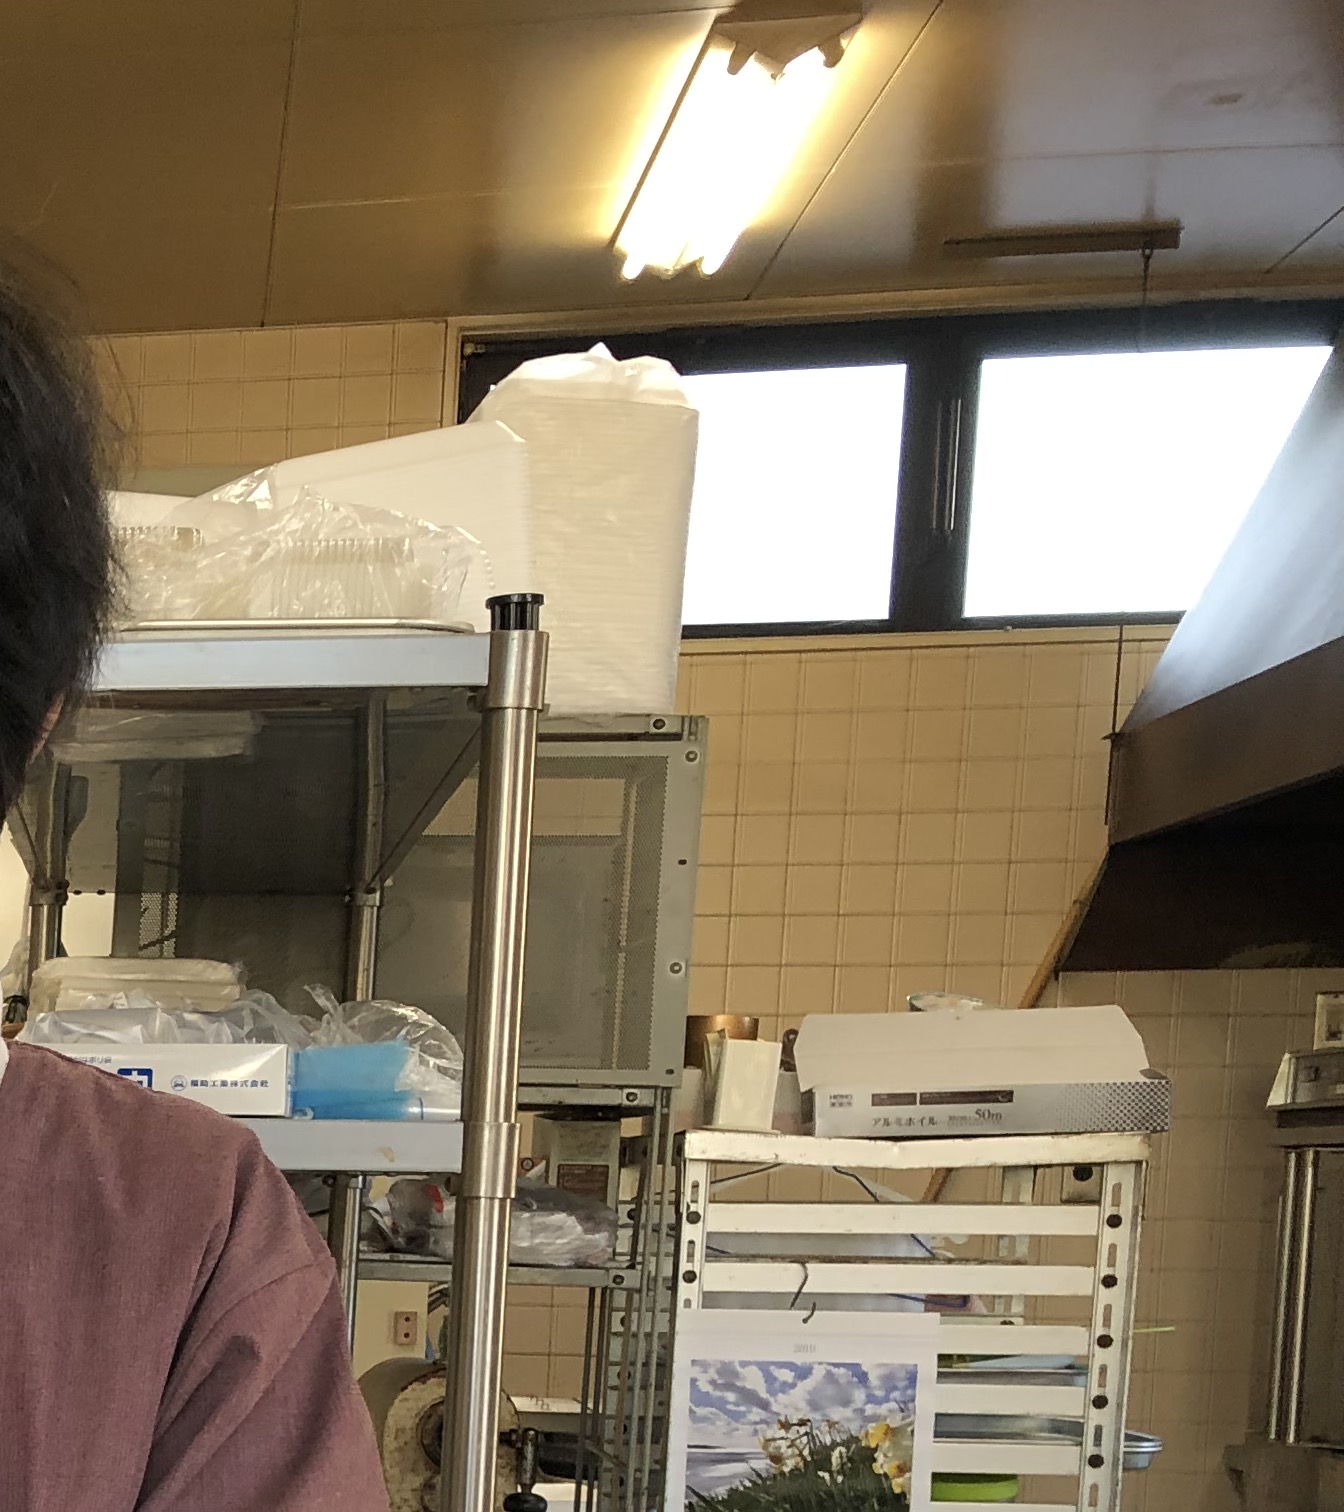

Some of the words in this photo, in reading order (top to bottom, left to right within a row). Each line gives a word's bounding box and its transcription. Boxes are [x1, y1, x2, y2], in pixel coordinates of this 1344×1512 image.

[975, 1108, 1002, 1122] 50m
[872, 1116, 938, 1127] アルミホイル
